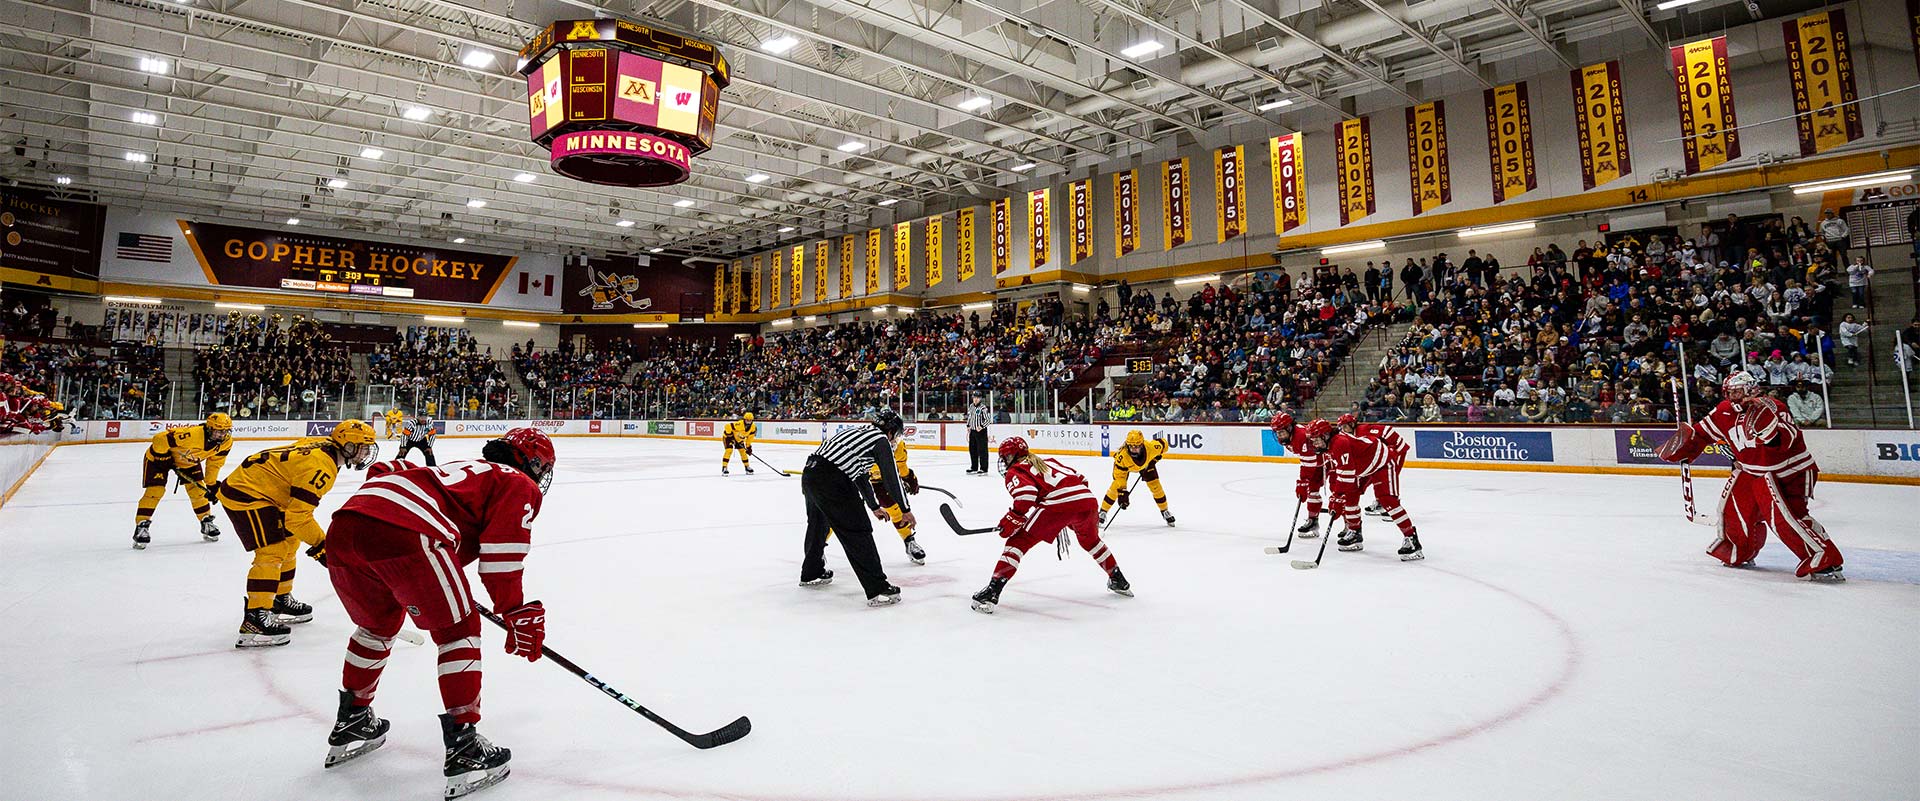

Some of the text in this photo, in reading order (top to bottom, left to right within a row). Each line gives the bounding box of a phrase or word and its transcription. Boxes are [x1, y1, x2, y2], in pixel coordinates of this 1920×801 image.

[566, 21, 600, 40] M
[618, 22, 648, 35] MINNESOTA
[684, 38, 713, 52] WISCONSIN
[624, 81, 650, 100] M
[1790, 42, 1810, 140] TOURNAMENT
[1808, 36, 1837, 118] 2014
[1836, 32, 1856, 122] CHAMPIONS
[675, 92, 692, 106] W
[1677, 66, 1694, 159] TOURNAMENT
[1692, 62, 1718, 139] 2013
[1718, 57, 1735, 143] CHAMPIONS
[1501, 103, 1519, 172] 2005
[1520, 100, 1533, 175] CHAMPIONS
[1576, 88, 1591, 176] TOURNAMENT
[1590, 84, 1612, 158] 2012
[1611, 80, 1626, 160] CHAMPIONS
[566, 134, 684, 162] MINNESOTA
[1348, 136, 1362, 198] 2002
[1363, 134, 1372, 201] CHAMPIONS
[1409, 124, 1419, 202] TOURNAMENT
[1420, 121, 1436, 186] 2004
[1438, 118, 1448, 190] CHAMPIONS
[1488, 106, 1502, 190] TOURNAMENT
[1225, 162, 1236, 218] 2015
[1282, 149, 1295, 209] 2016
[1296, 146, 1304, 212] CHAMPIONS
[1338, 138, 1346, 214] TOURNAMENT
[1628, 188, 1648, 203] 14
[10, 198, 60, 216] HOCKEY
[1077, 194, 1085, 244] 2005
[1122, 184, 1131, 236] 2012
[1172, 173, 1182, 227] 2013
[224, 239, 484, 280] GOPHER HOCKEY
[277, 236, 331, 246] UNIVERSITY
[370, 246, 426, 256] MINNESOTA
[346, 272, 361, 280] 3:03
[998, 280, 1006, 288] 12
[142, 304, 185, 312] OLYMPIANS
[1132, 360, 1151, 372] 3:03
[178, 432, 191, 440] 5
[1040, 430, 1094, 439] TRUSTONE
[1168, 434, 1203, 449] UHC
[1443, 441, 1529, 461] Scientific
[1454, 432, 1506, 447] Boston
[1341, 452, 1350, 465] 17
[308, 470, 331, 490] 15
[1007, 476, 1020, 490] 26
[1721, 474, 1736, 499] CCM
[585, 673, 641, 710] CCM
[457, 758, 482, 769] CCM
